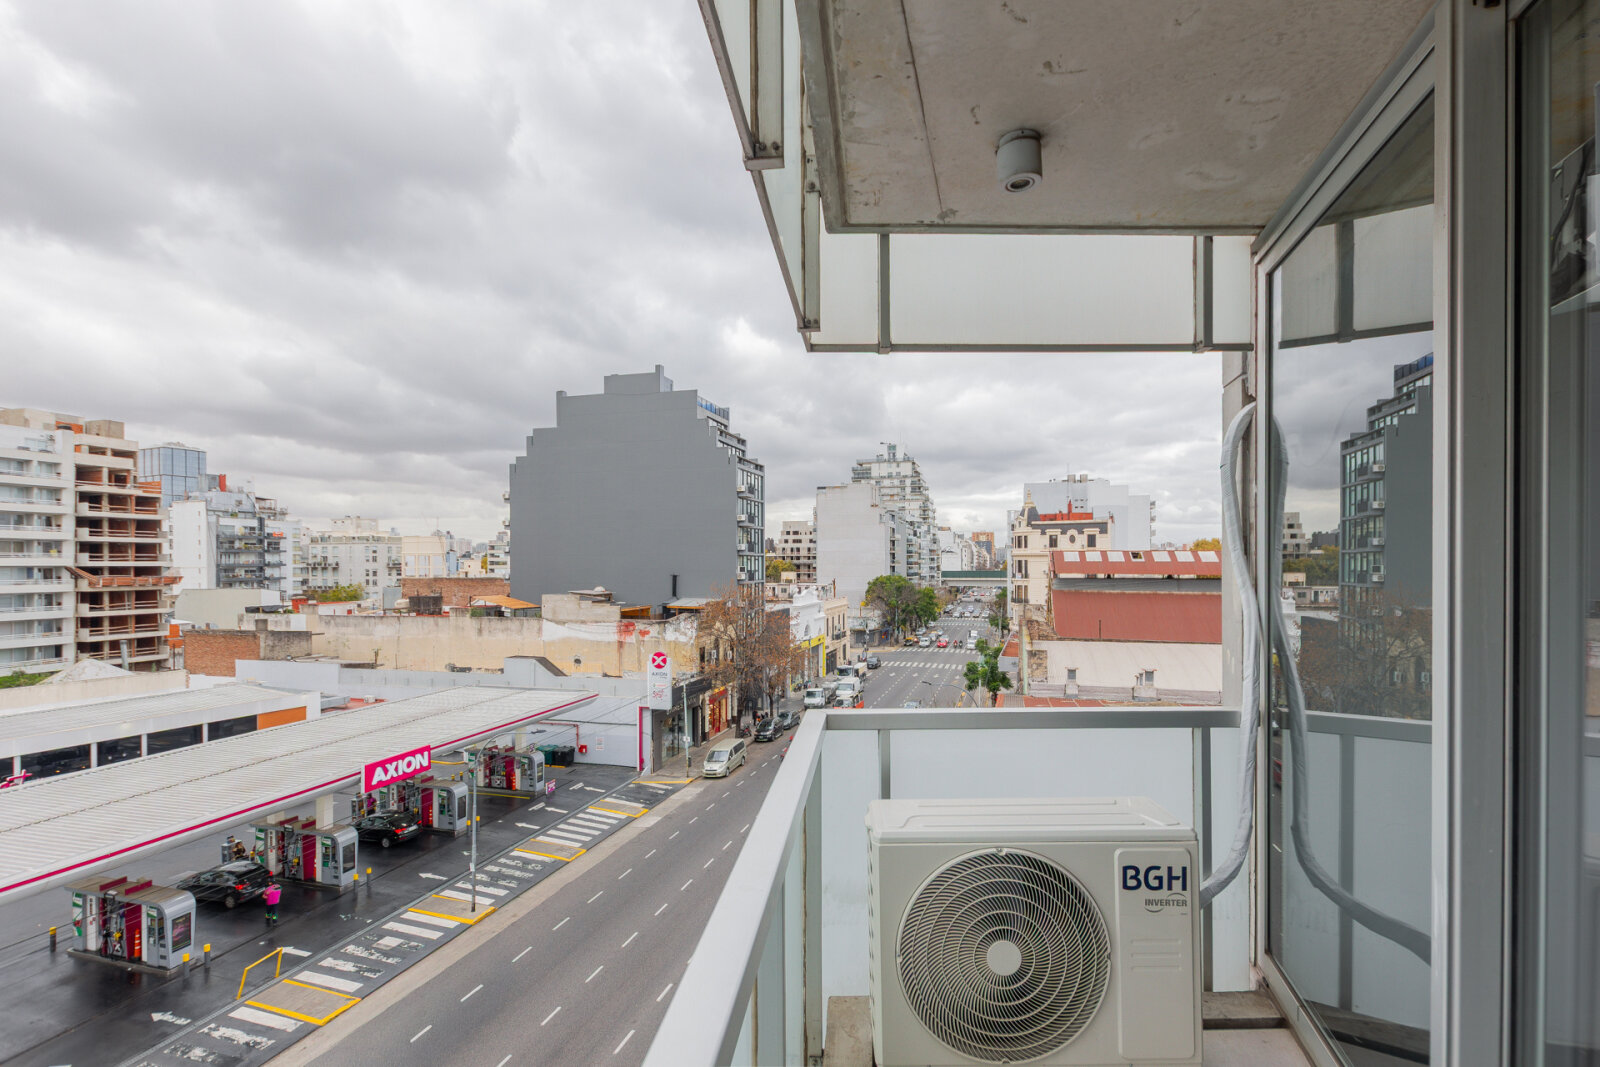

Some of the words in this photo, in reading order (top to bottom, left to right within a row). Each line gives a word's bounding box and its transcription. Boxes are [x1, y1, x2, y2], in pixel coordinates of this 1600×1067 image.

[371, 751, 429, 786] AXION
[1122, 865, 1187, 891] BGH
[1144, 898, 1188, 907] INVERTER
